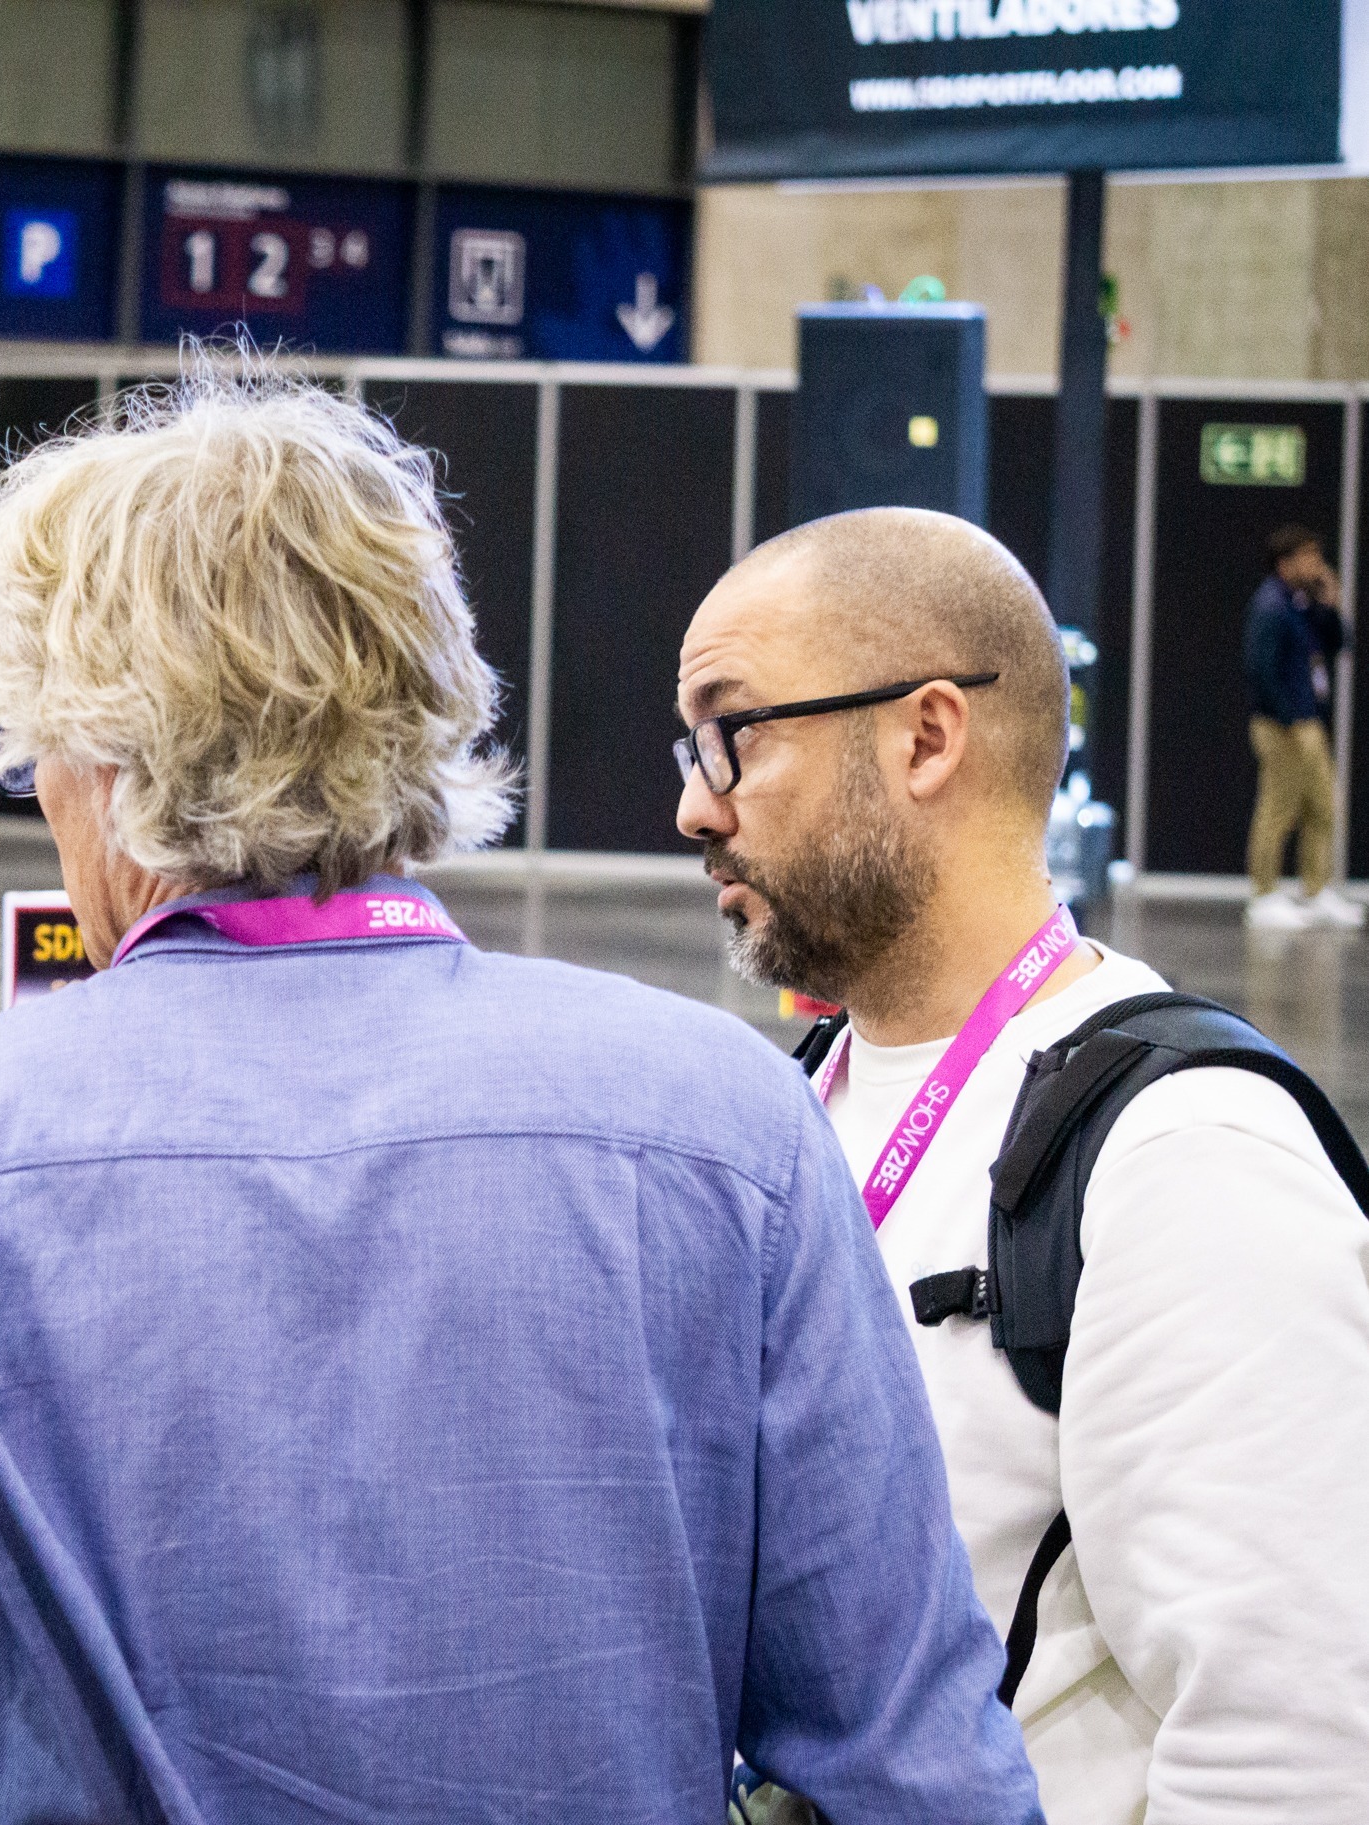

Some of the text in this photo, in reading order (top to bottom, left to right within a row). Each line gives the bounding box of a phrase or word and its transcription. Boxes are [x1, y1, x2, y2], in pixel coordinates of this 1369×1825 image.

[20, 221, 62, 283] P
[185, 231, 215, 293] 1
[247, 232, 289, 297] 2
[871, 1080, 950, 1195] SHOW2BE
